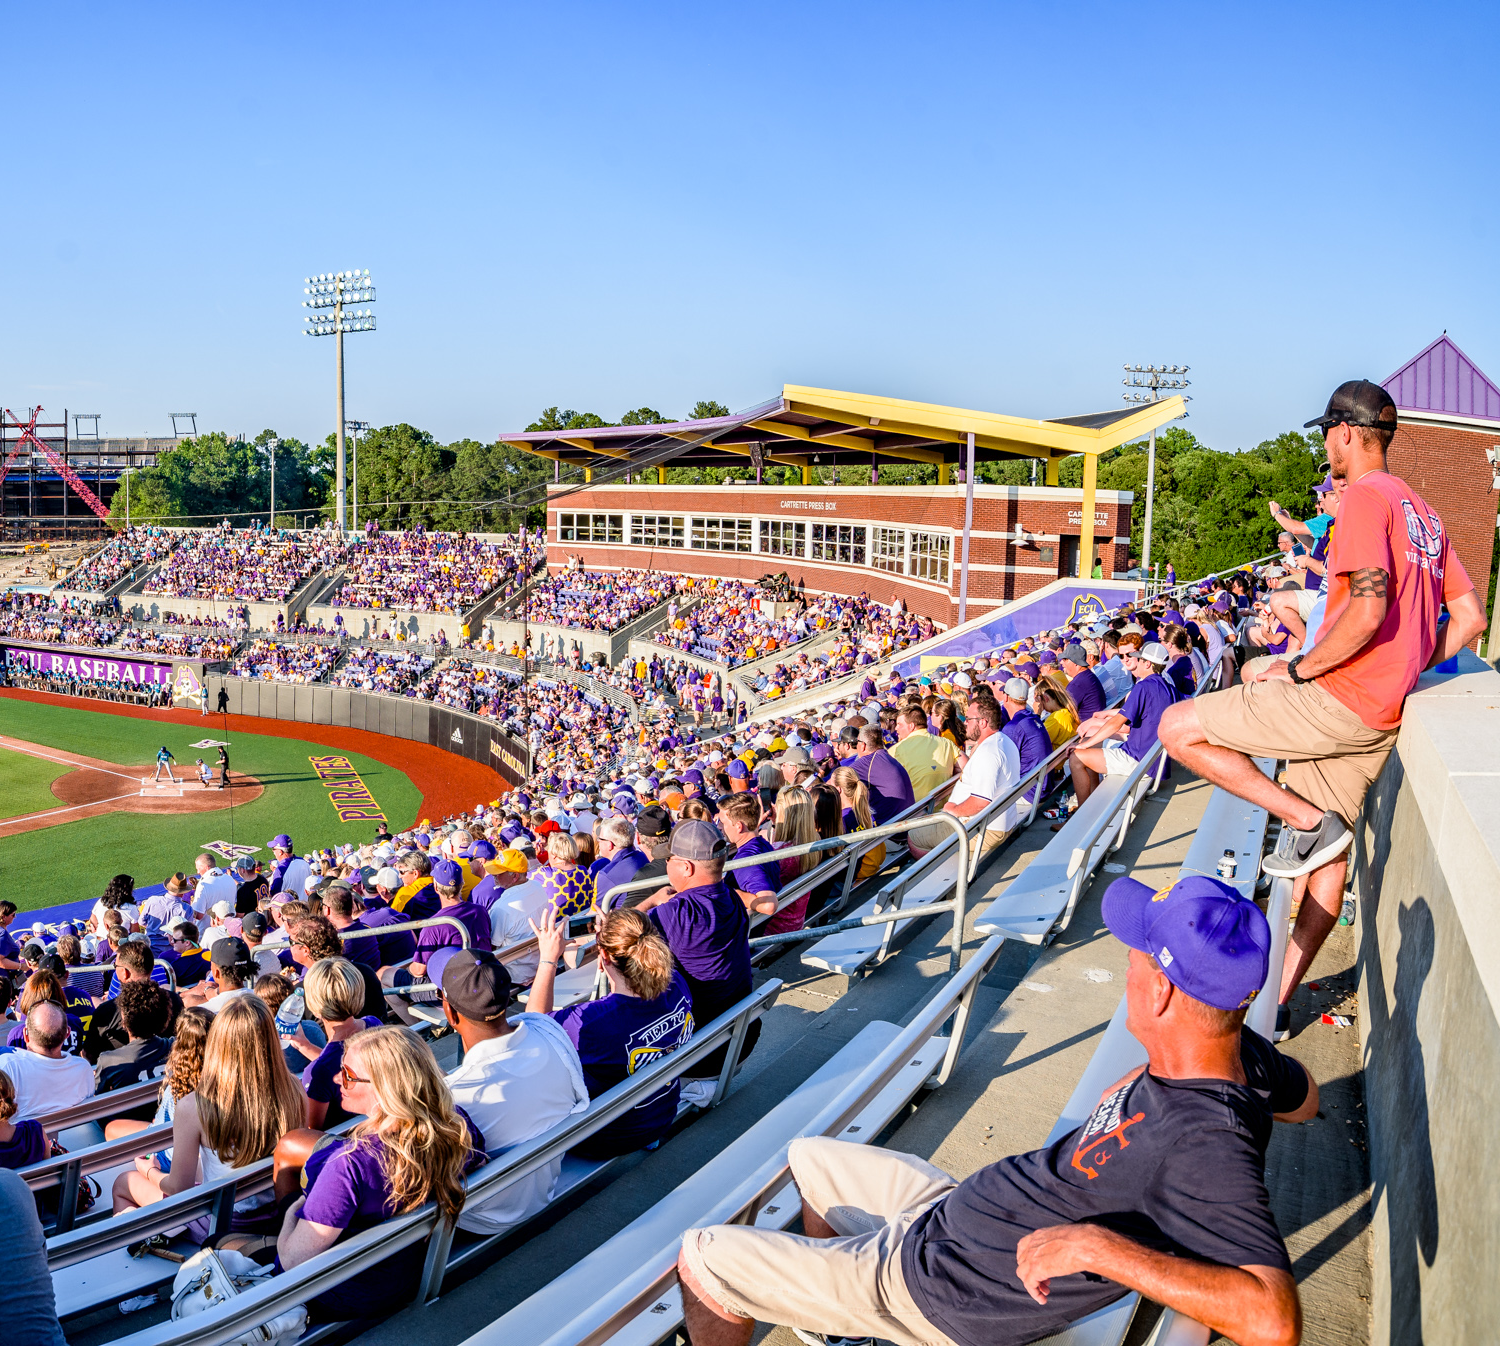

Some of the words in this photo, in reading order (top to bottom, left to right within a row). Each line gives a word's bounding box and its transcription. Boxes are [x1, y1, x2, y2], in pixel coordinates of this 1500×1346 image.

[780, 500, 808, 509] CARTRETTE
[808, 501, 824, 510] PRESS
[825, 502, 837, 511] BOX
[1067, 510, 1109, 520] CARTTE
[1078, 604, 1097, 614] ECU
[4, 649, 42, 672] ECU
[490, 739, 502, 760] EAST
[308, 755, 388, 823] PIRATES
[642, 1021, 669, 1044] TIED
[670, 1011, 685, 1027] TO
